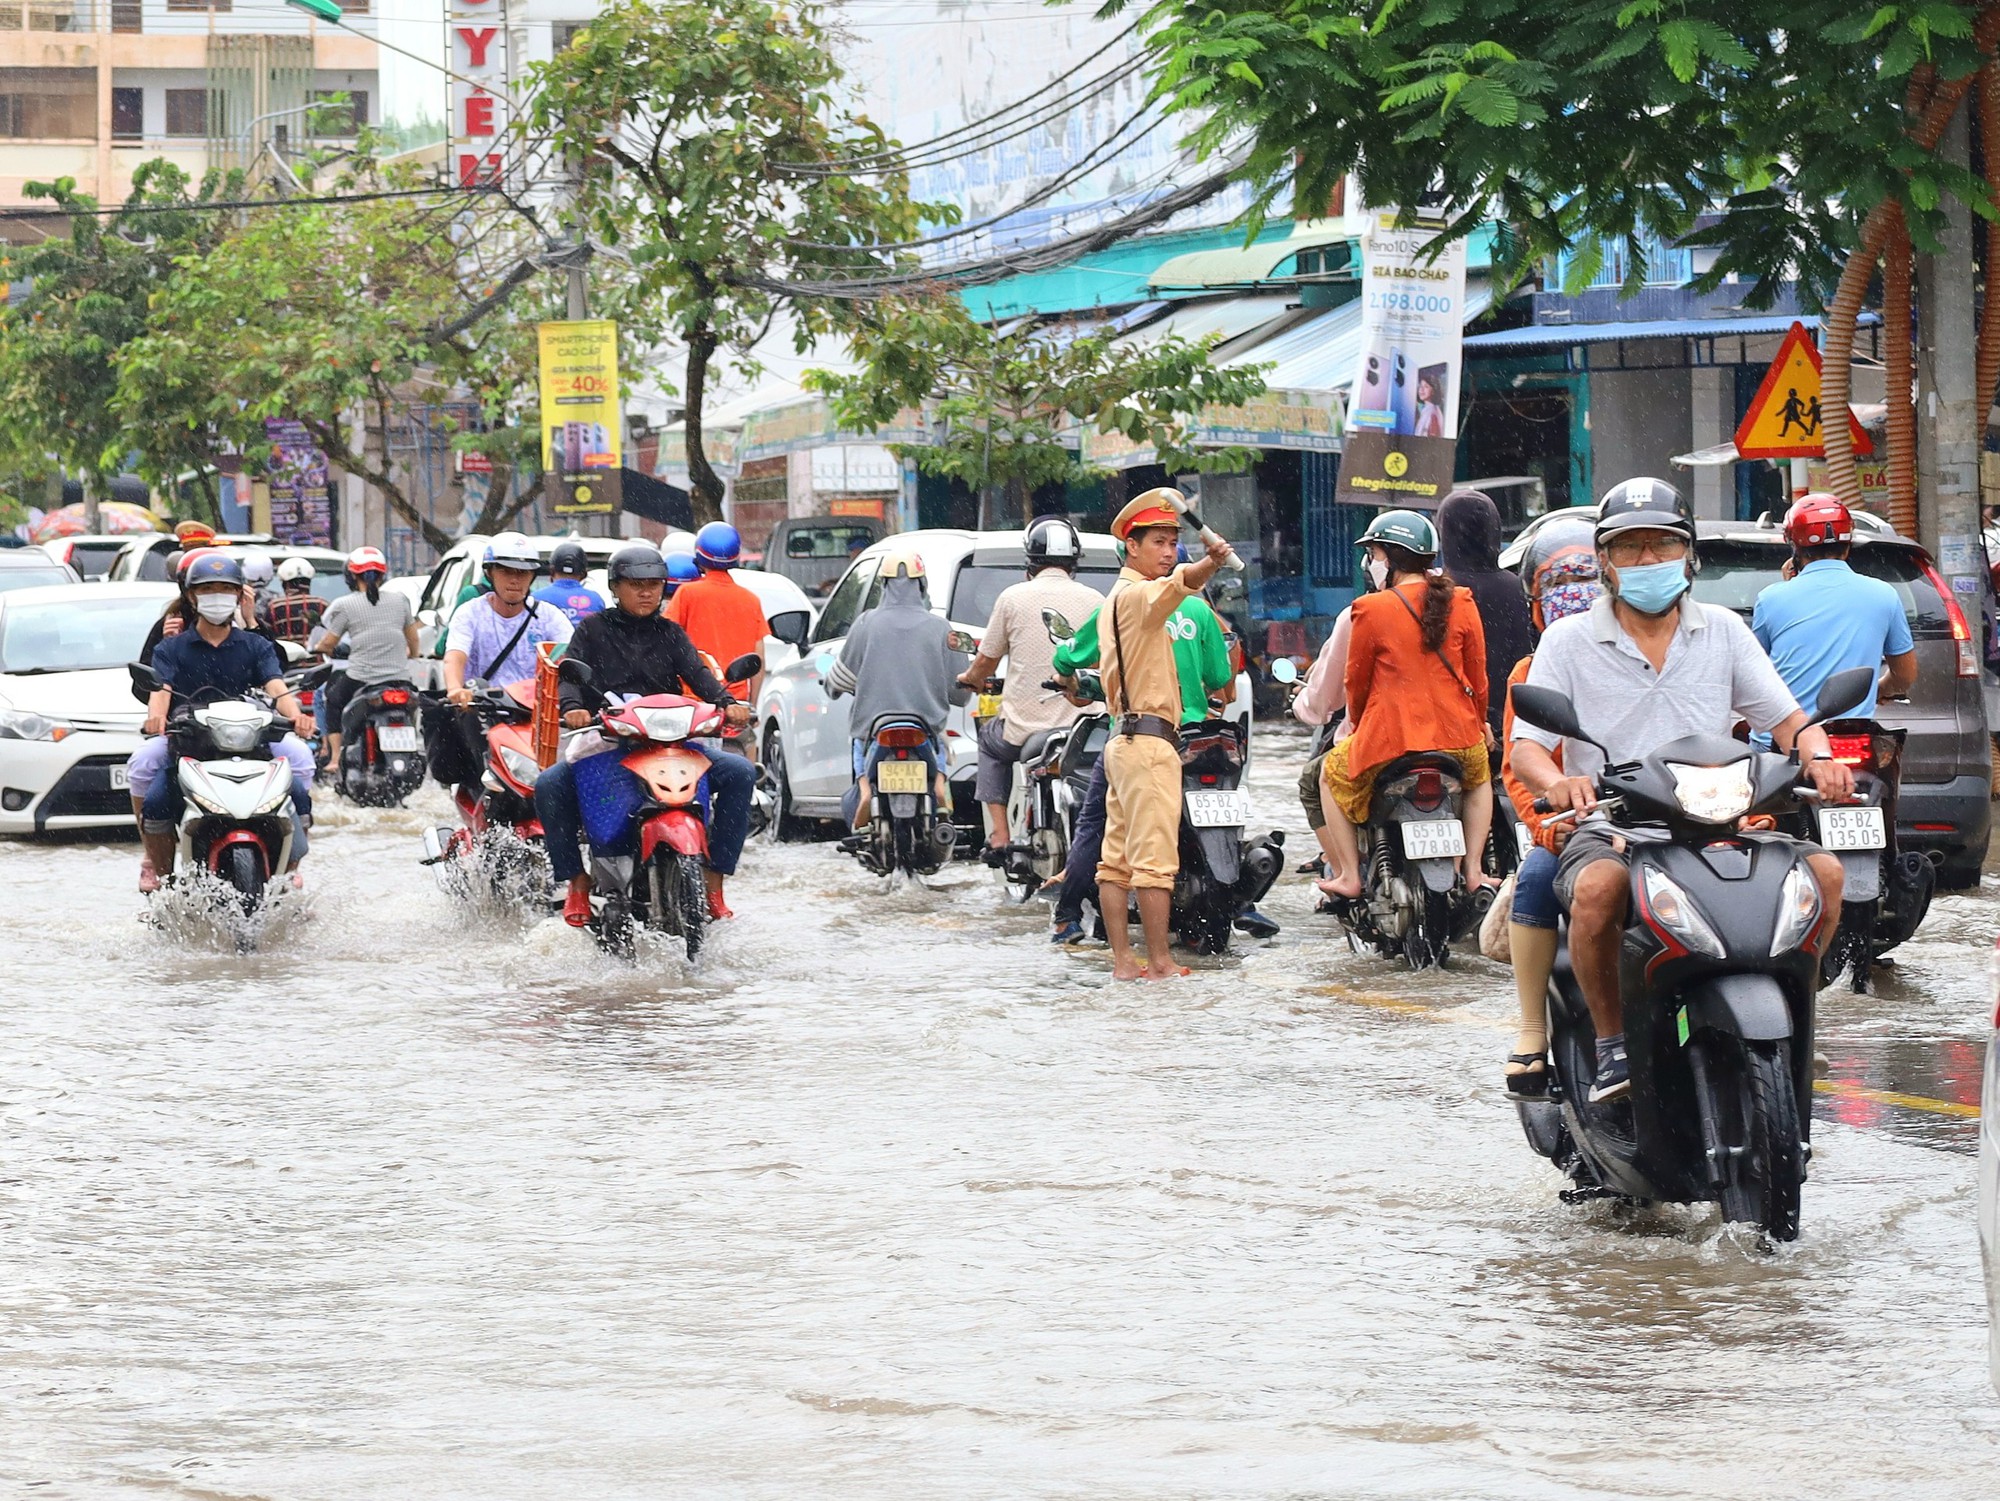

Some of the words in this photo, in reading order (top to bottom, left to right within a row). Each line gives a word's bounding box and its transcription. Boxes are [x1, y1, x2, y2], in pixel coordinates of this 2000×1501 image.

[1370, 292, 1451, 313] 2.198.000
[571, 375, 609, 393] 40%
[1351, 476, 1438, 496] thegioididong
[1193, 809, 1242, 824] 512.92
[1829, 811, 1873, 829] 65-B2
[1412, 823, 1452, 839] 65-B1
[1827, 828, 1881, 847] 135.05
[1409, 838, 1461, 856] 178.88
